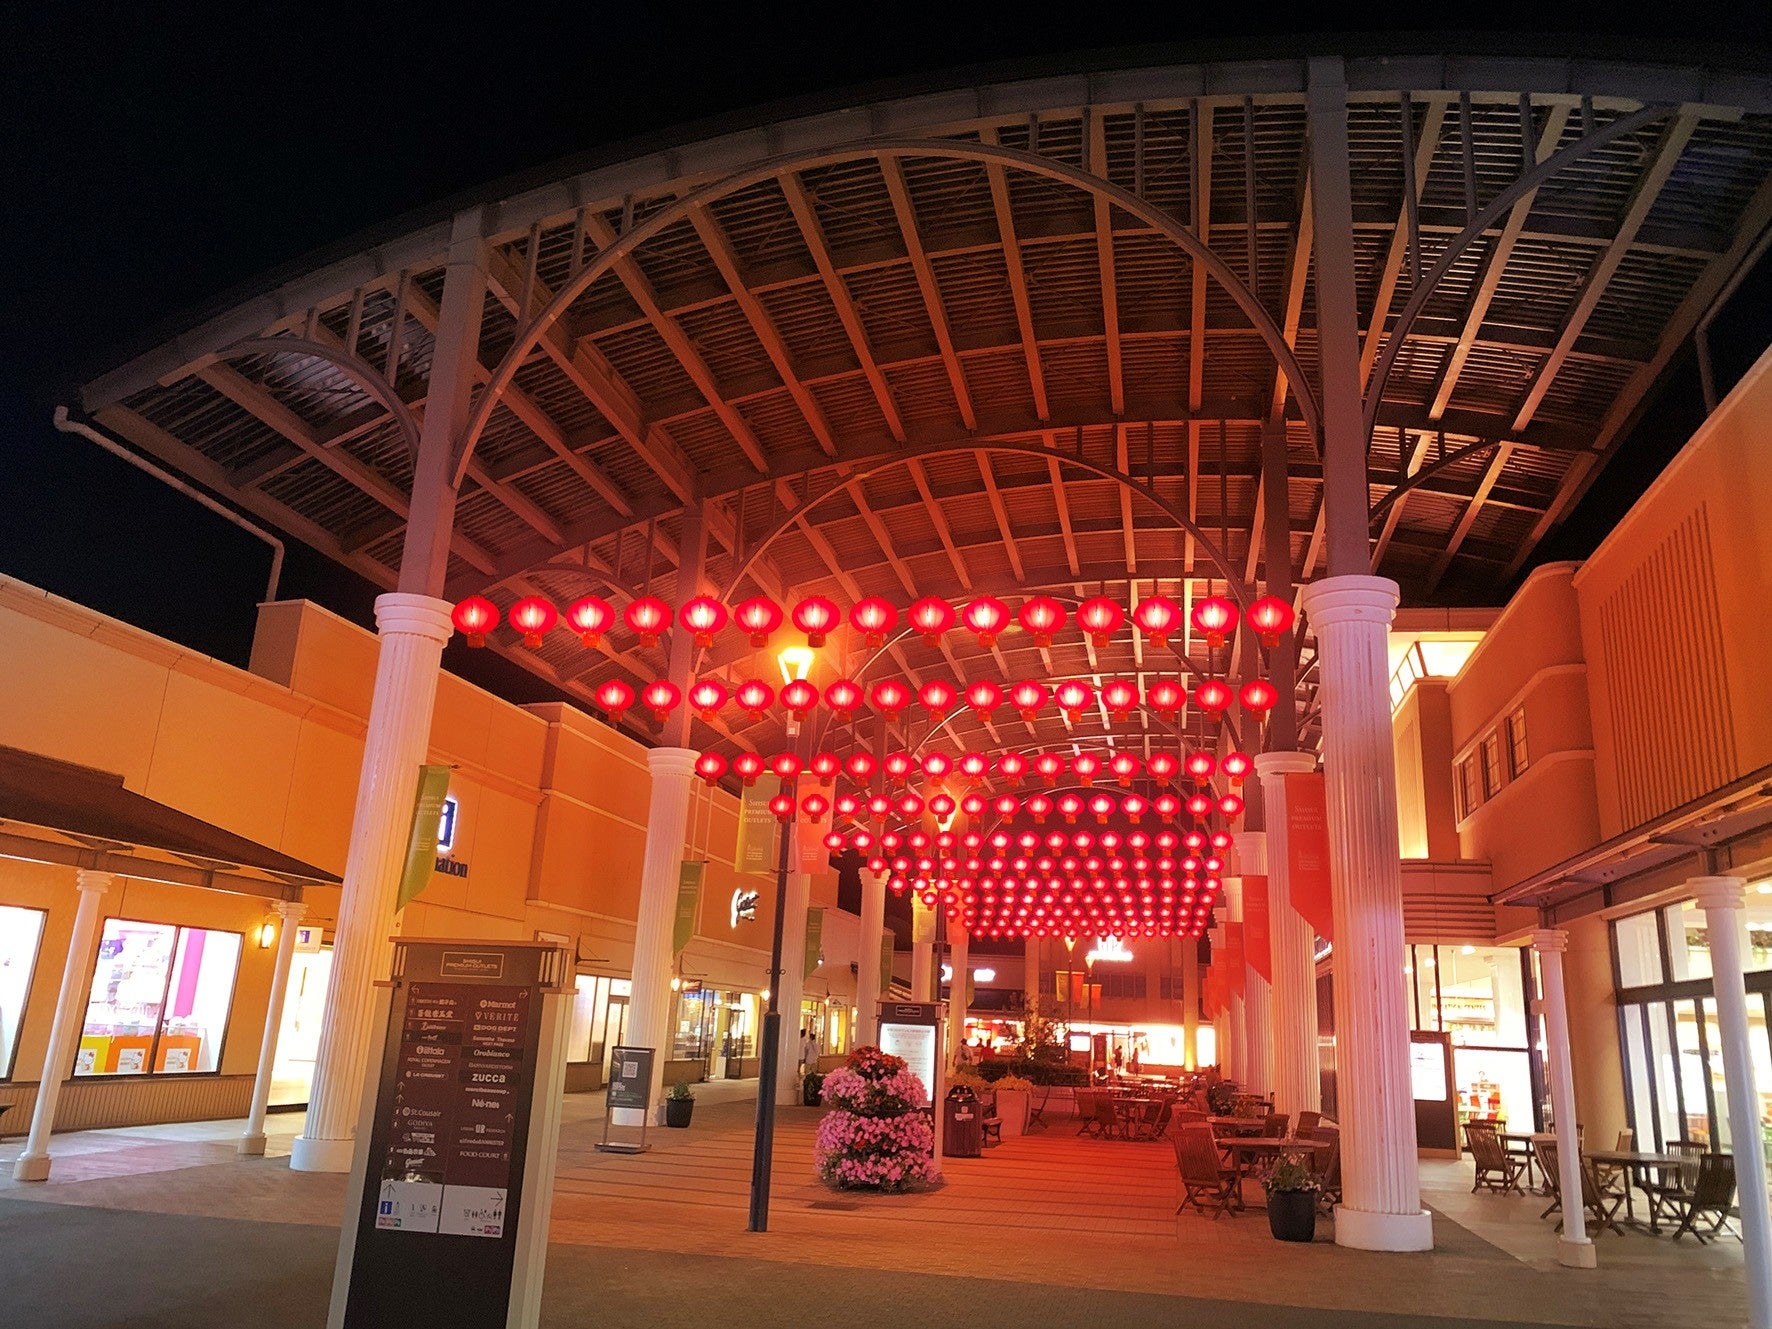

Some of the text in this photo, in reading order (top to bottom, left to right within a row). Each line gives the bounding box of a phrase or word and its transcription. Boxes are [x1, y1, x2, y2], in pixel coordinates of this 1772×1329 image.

[488, 1000, 517, 1009] Marmot
[473, 1049, 511, 1058] Orobianco
[471, 1073, 507, 1084] zucca
[407, 1119, 433, 1127] GODIVA
[459, 1150, 478, 1158] FOOD
